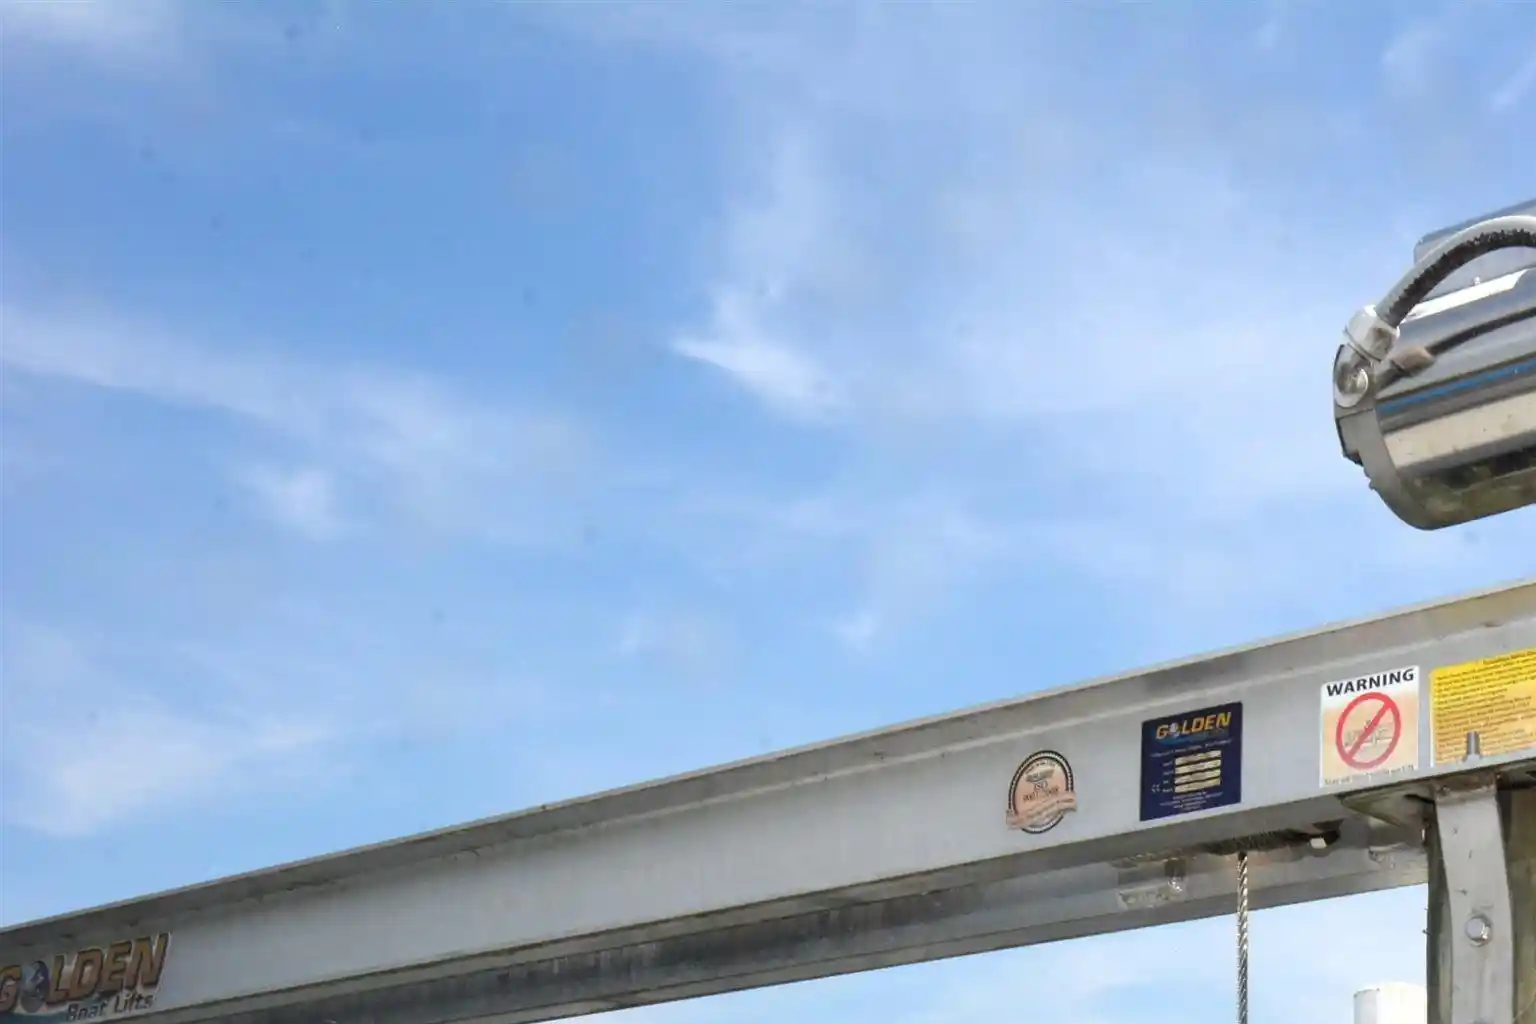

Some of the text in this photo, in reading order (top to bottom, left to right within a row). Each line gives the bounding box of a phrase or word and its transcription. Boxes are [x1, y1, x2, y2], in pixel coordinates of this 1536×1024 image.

[1327, 668, 1414, 697] WARNING
[1157, 712, 1231, 739] GOLDEN
[0, 932, 171, 1014] GOLDEN
